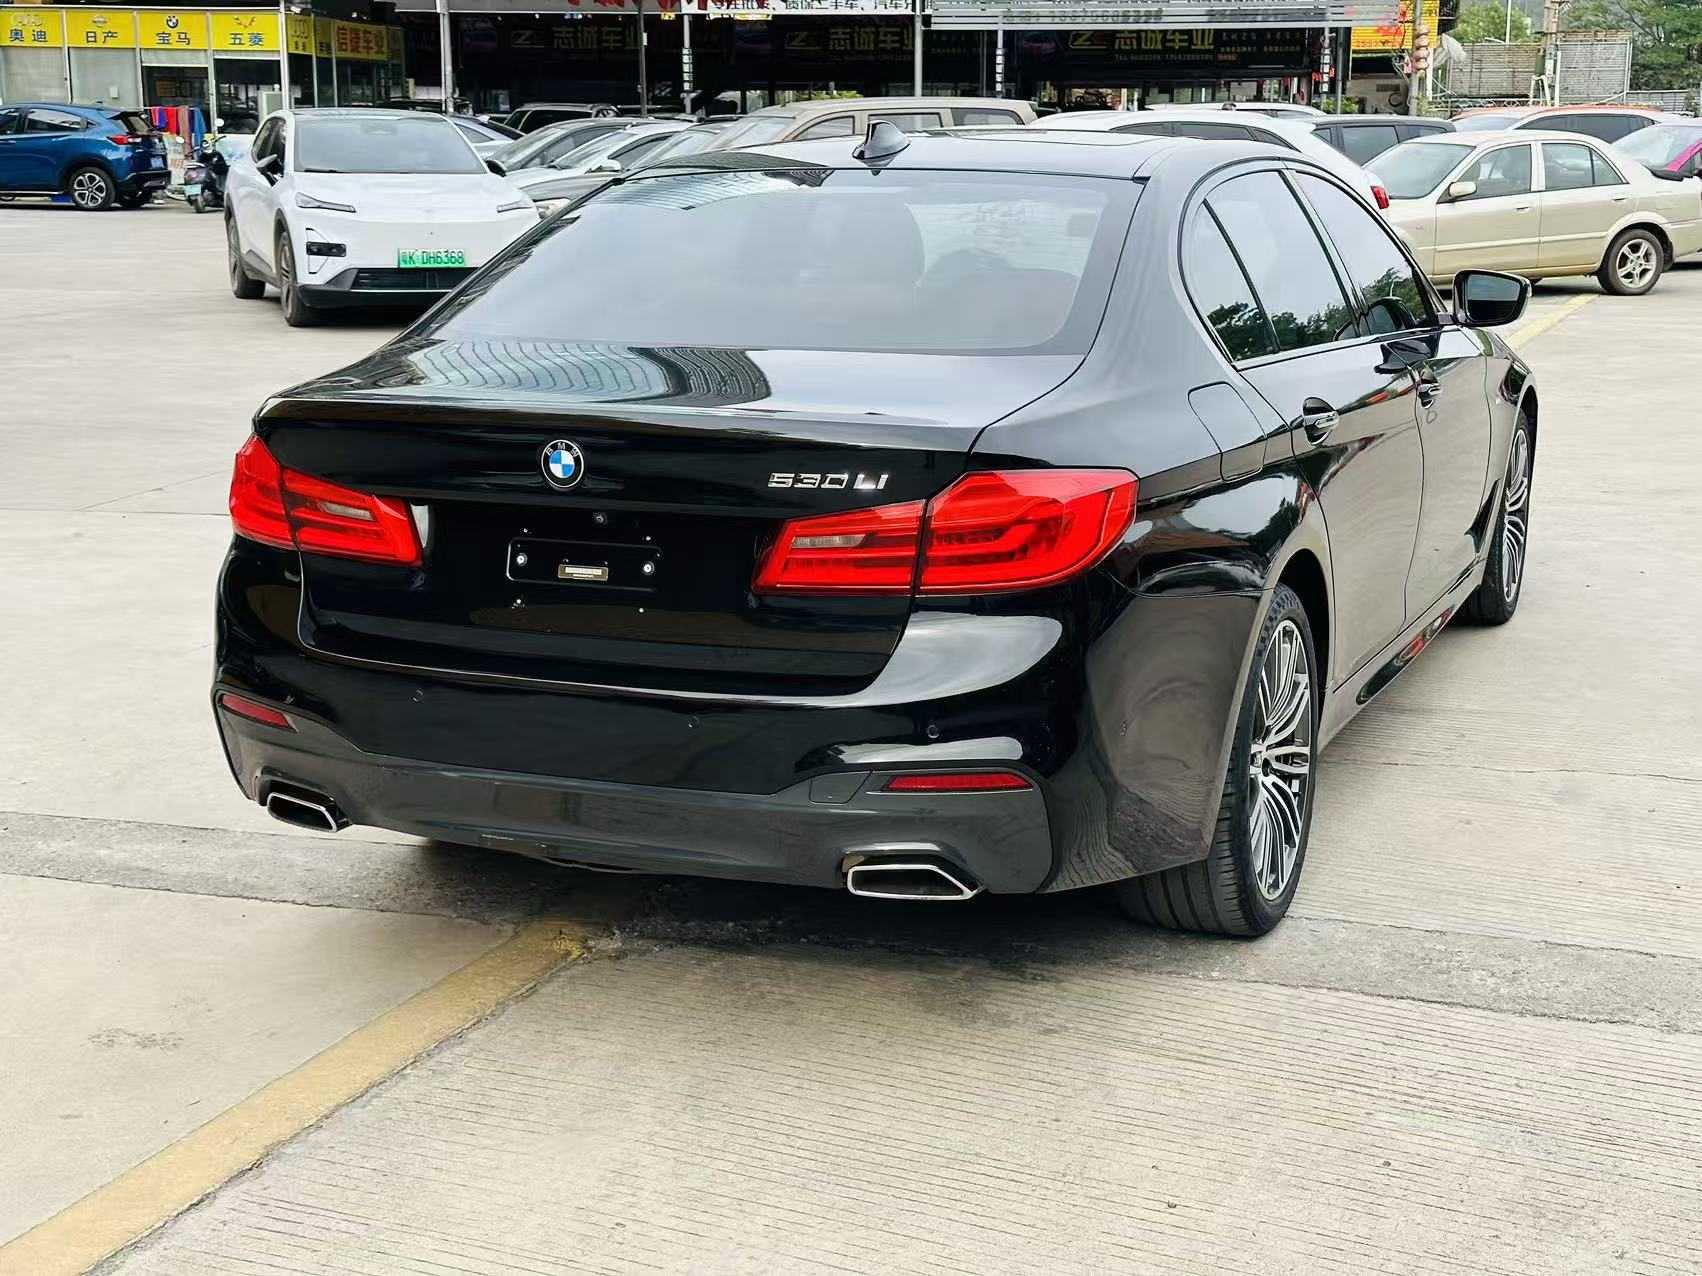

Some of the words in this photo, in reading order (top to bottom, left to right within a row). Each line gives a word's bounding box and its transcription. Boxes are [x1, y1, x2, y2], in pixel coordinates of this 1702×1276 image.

[9, 28, 48, 42] 奥迪
[86, 30, 118, 43] 日产
[156, 31, 190, 45] 宝马
[228, 32, 264, 46] 五菱
[1113, 28, 1215, 50] 志诚车业
[545, 441, 579, 457] BMW
